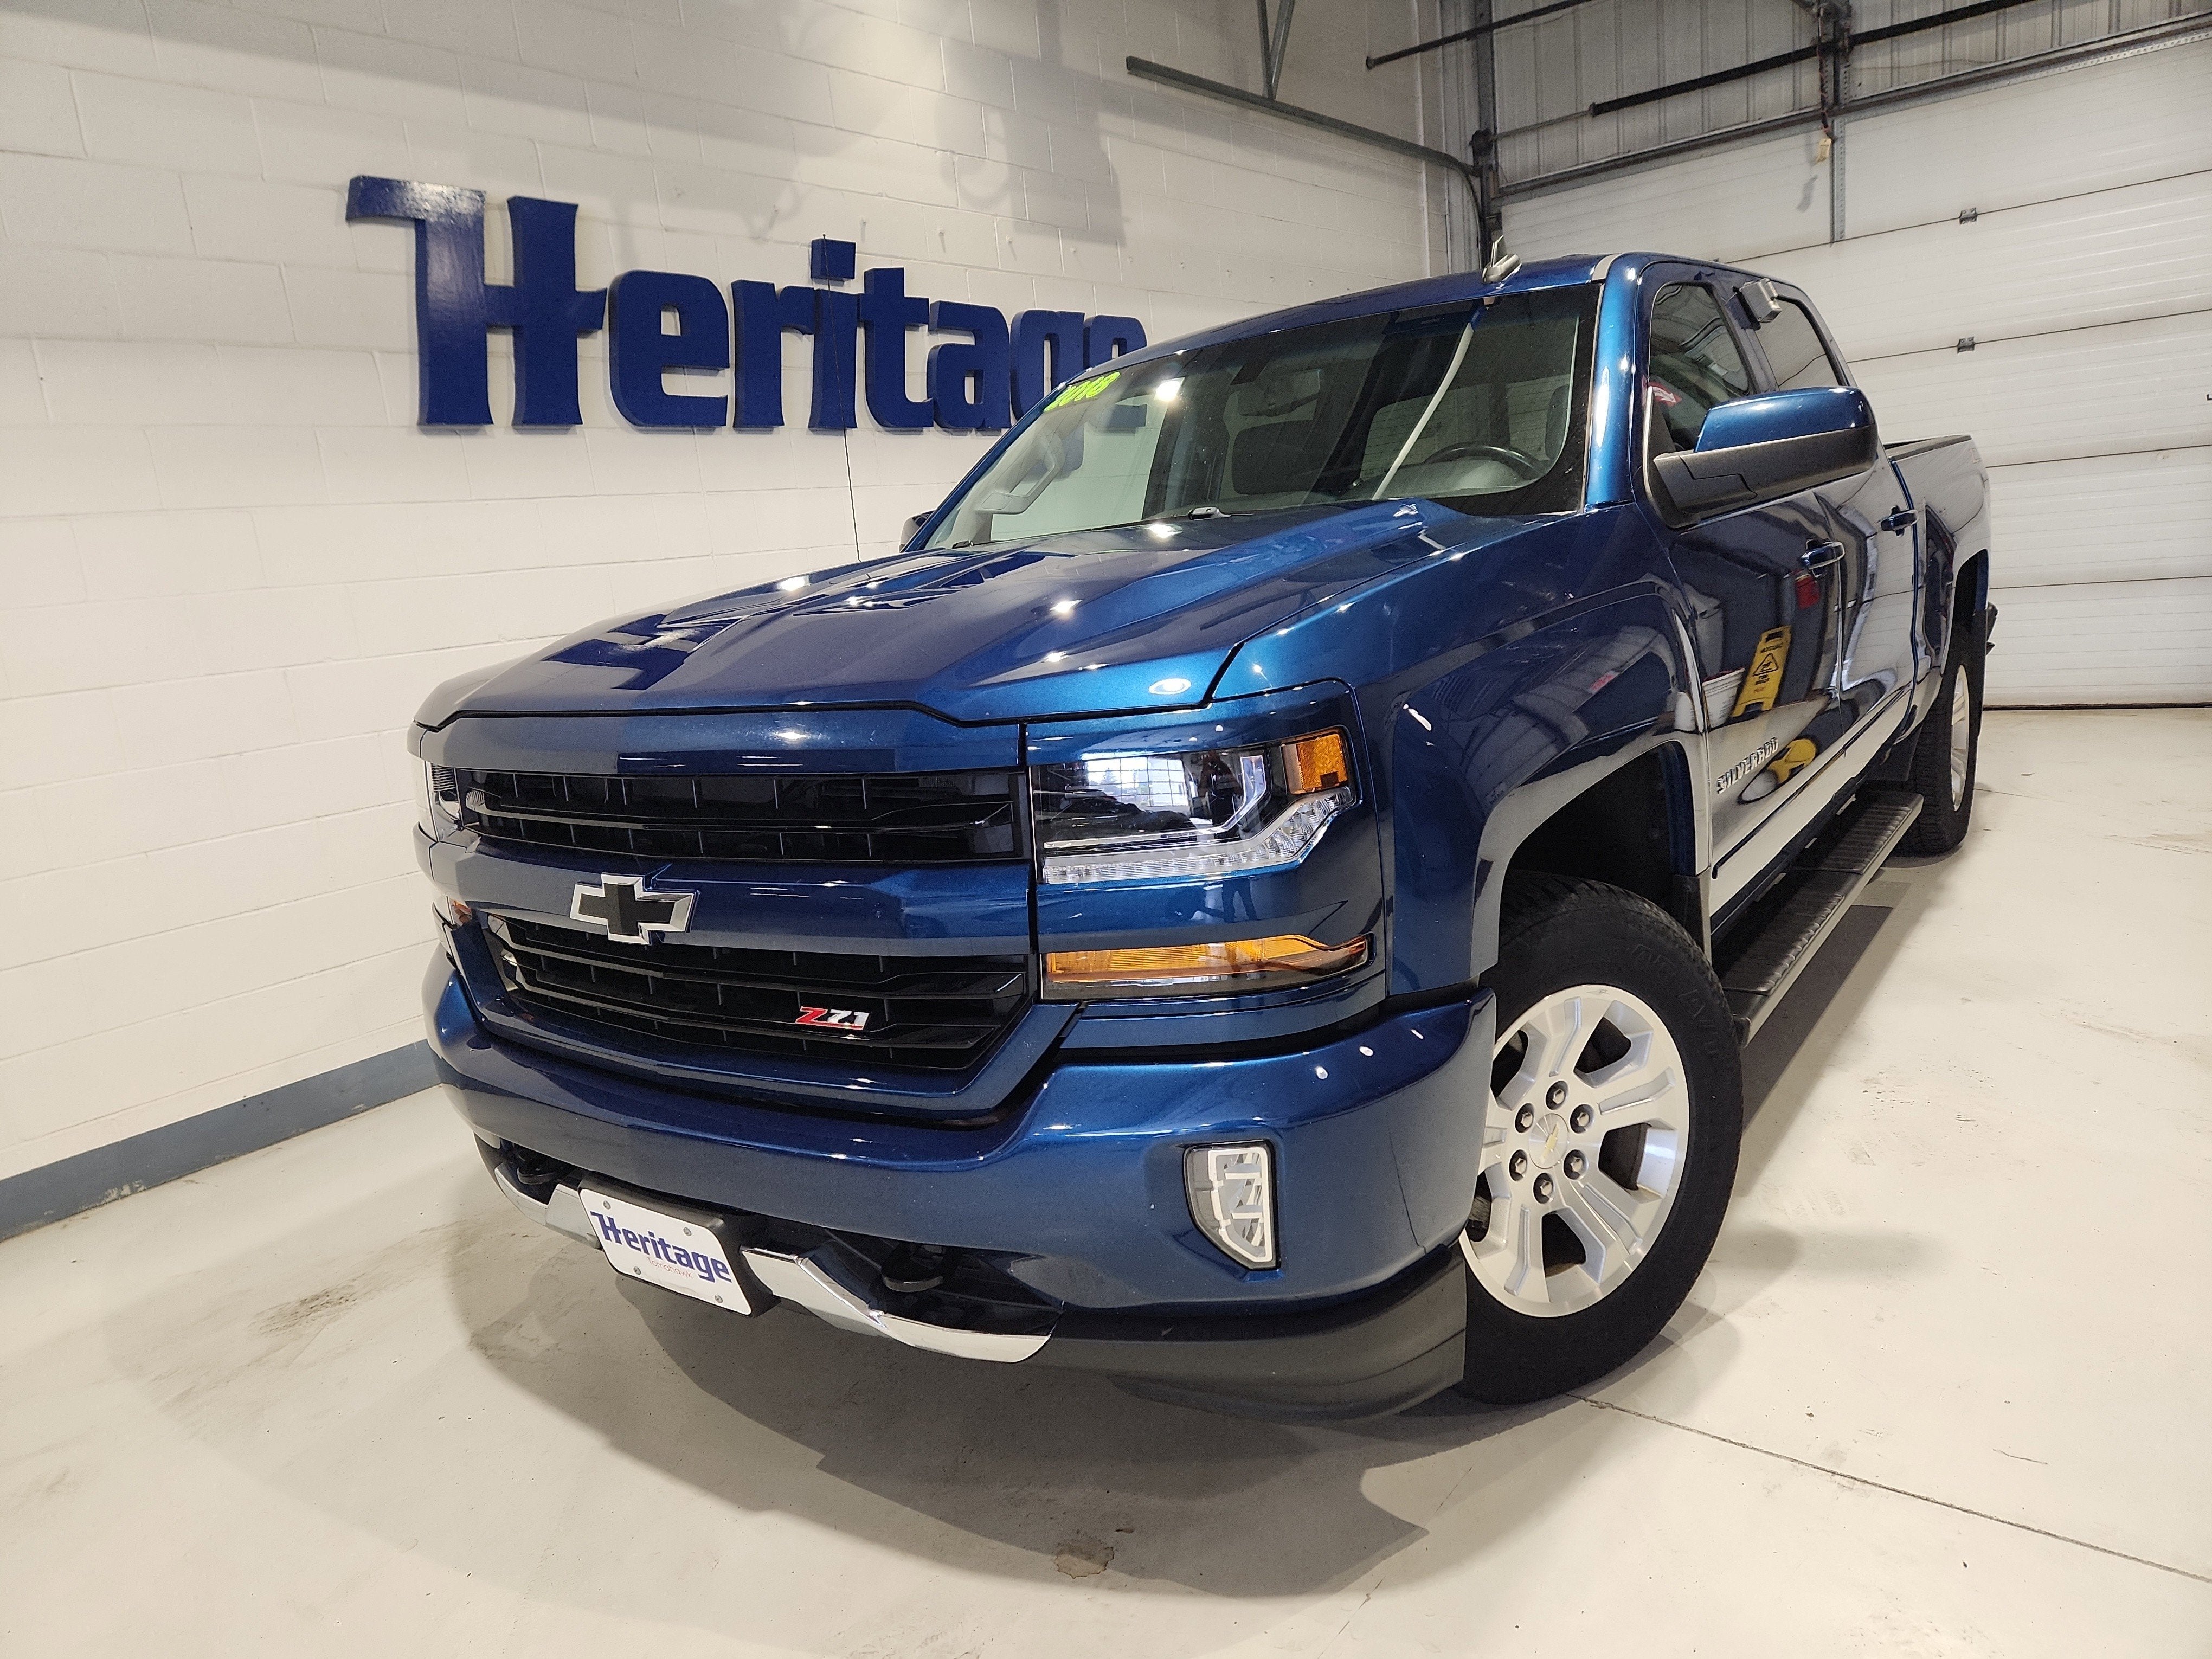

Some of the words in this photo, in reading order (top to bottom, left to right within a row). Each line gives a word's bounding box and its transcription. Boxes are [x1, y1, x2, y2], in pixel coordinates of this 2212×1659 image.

[1043, 372, 1121, 413] 2018
[1716, 737, 1778, 794] SILVERADO
[795, 1006, 870, 1031] Z71
[590, 1211, 732, 1283] Heritage
